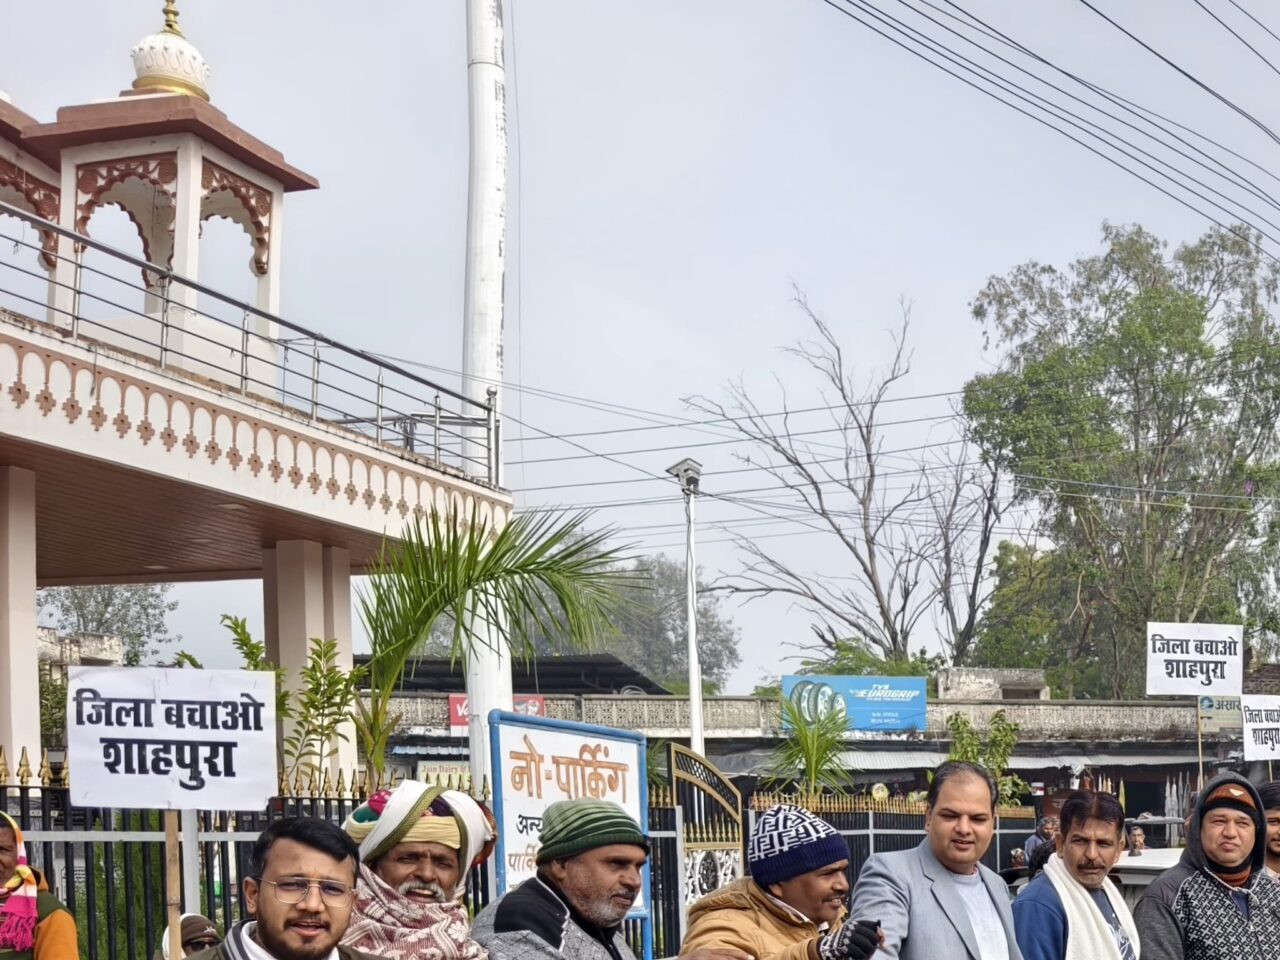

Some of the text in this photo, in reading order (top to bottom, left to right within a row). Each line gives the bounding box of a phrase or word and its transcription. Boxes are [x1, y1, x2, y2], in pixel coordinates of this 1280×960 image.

[1151, 634, 1238, 656] जिला बचाओ
[1164, 659, 1226, 686] शाहपुरा
[858, 689, 920, 698] EUROGRIP
[73, 688, 265, 731] जिला बचाओ
[1243, 706, 1263, 723] जिला
[1252, 727, 1280, 750] शाहपुरा
[99, 738, 238, 791] शाहपुरा
